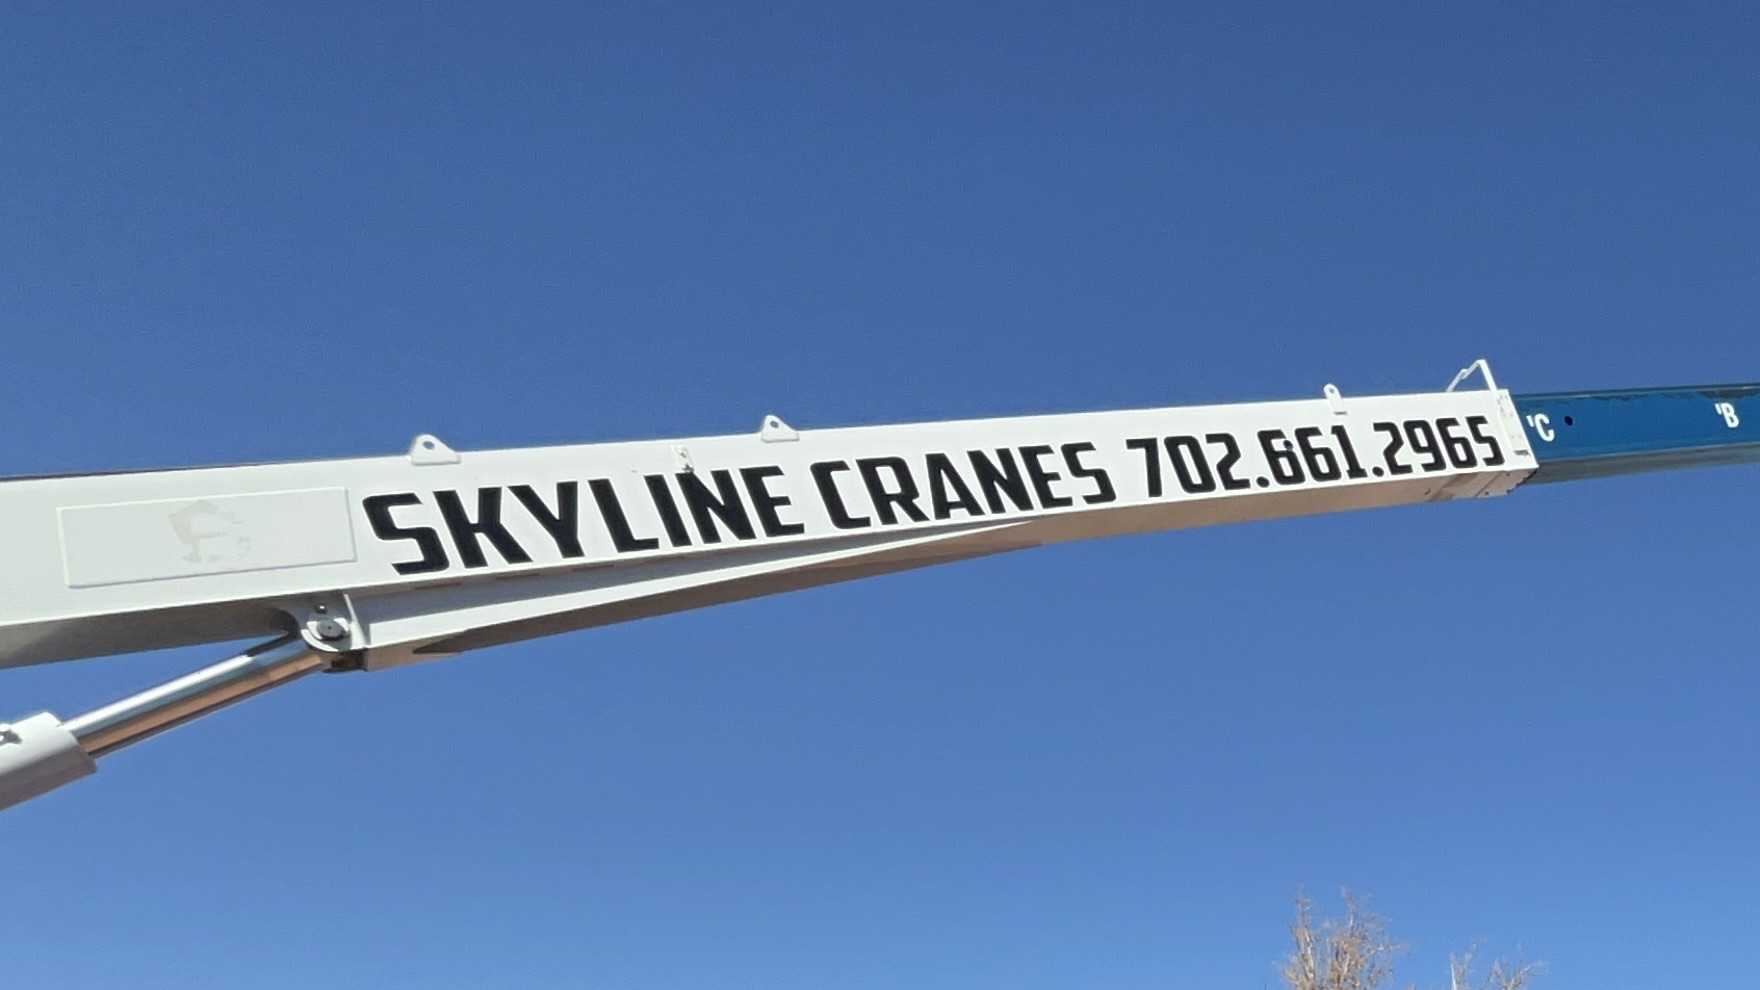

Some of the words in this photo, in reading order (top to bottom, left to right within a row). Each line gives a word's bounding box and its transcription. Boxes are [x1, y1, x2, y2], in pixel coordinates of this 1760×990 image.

[361, 465, 805, 575] SKYLINE
[809, 441, 1118, 529] CRANES
[1126, 415, 1506, 499] 702.661.2965
